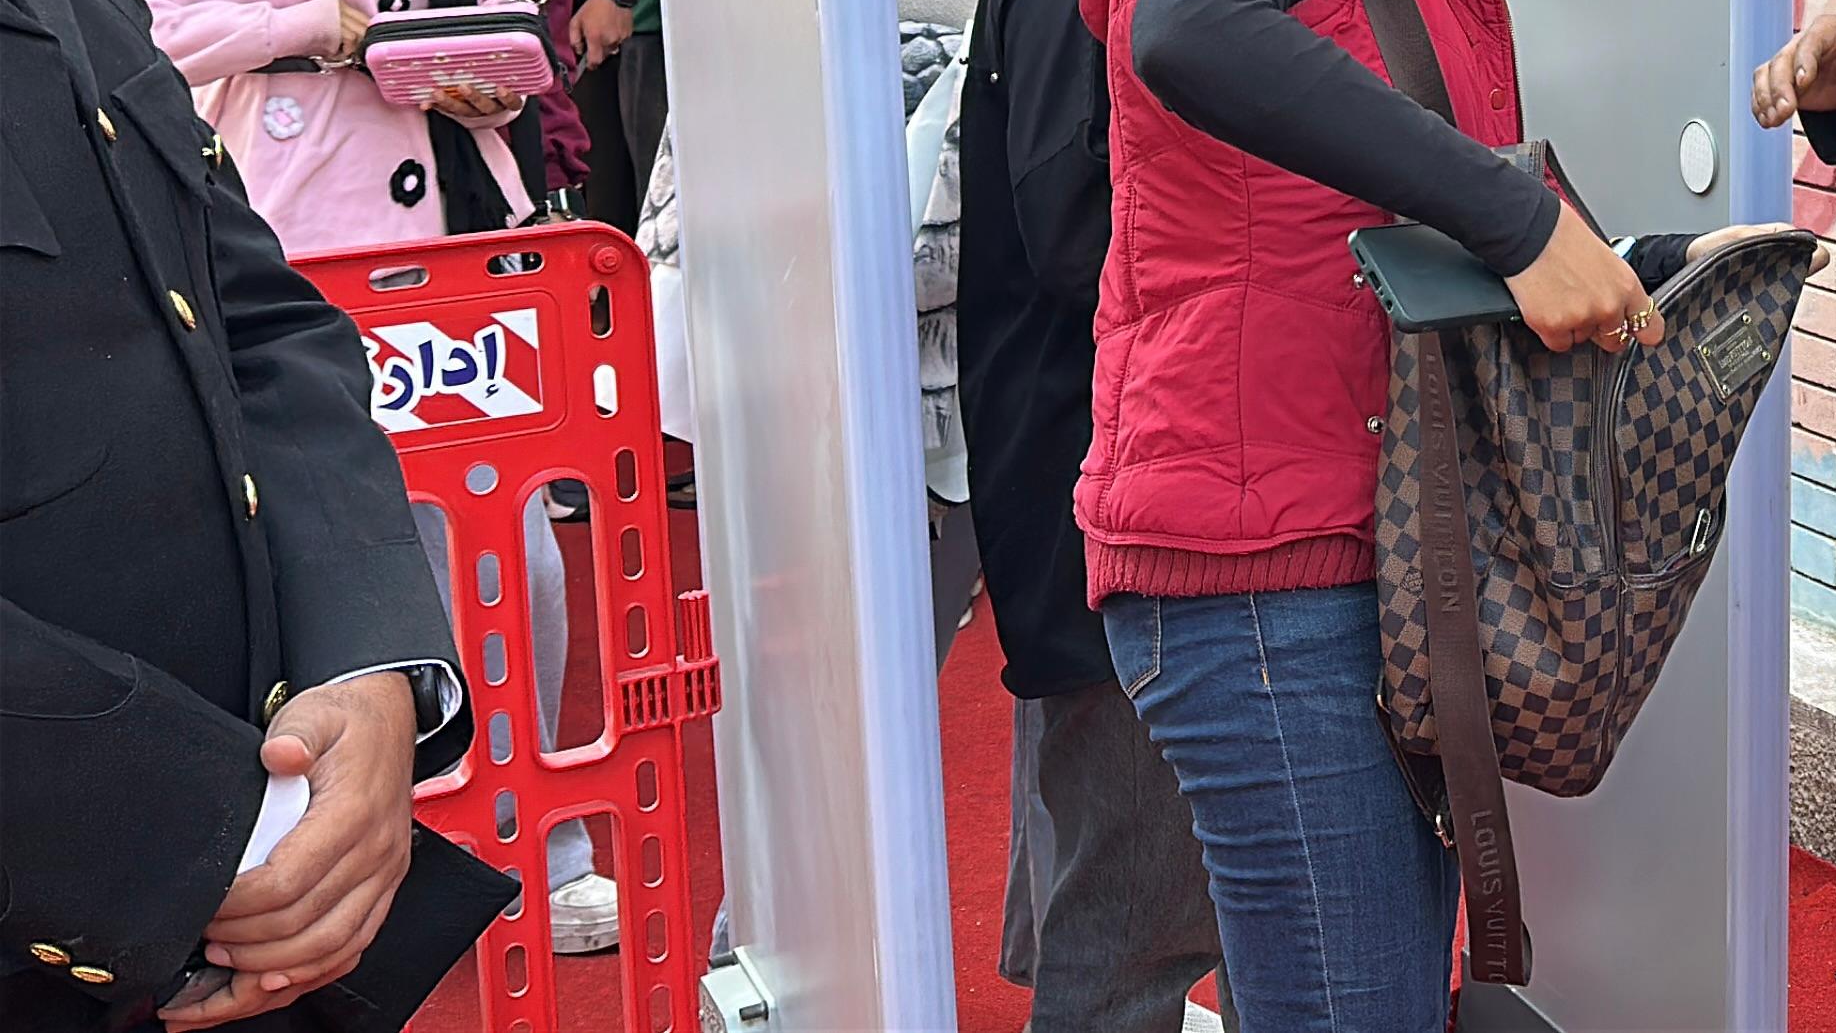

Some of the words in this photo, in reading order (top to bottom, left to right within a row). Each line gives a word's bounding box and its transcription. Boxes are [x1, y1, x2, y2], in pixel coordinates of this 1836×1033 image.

[376, 332, 500, 410] إدار
[1470, 810, 1502, 895] LOUIS
[1484, 898, 1508, 985] VUITTO
